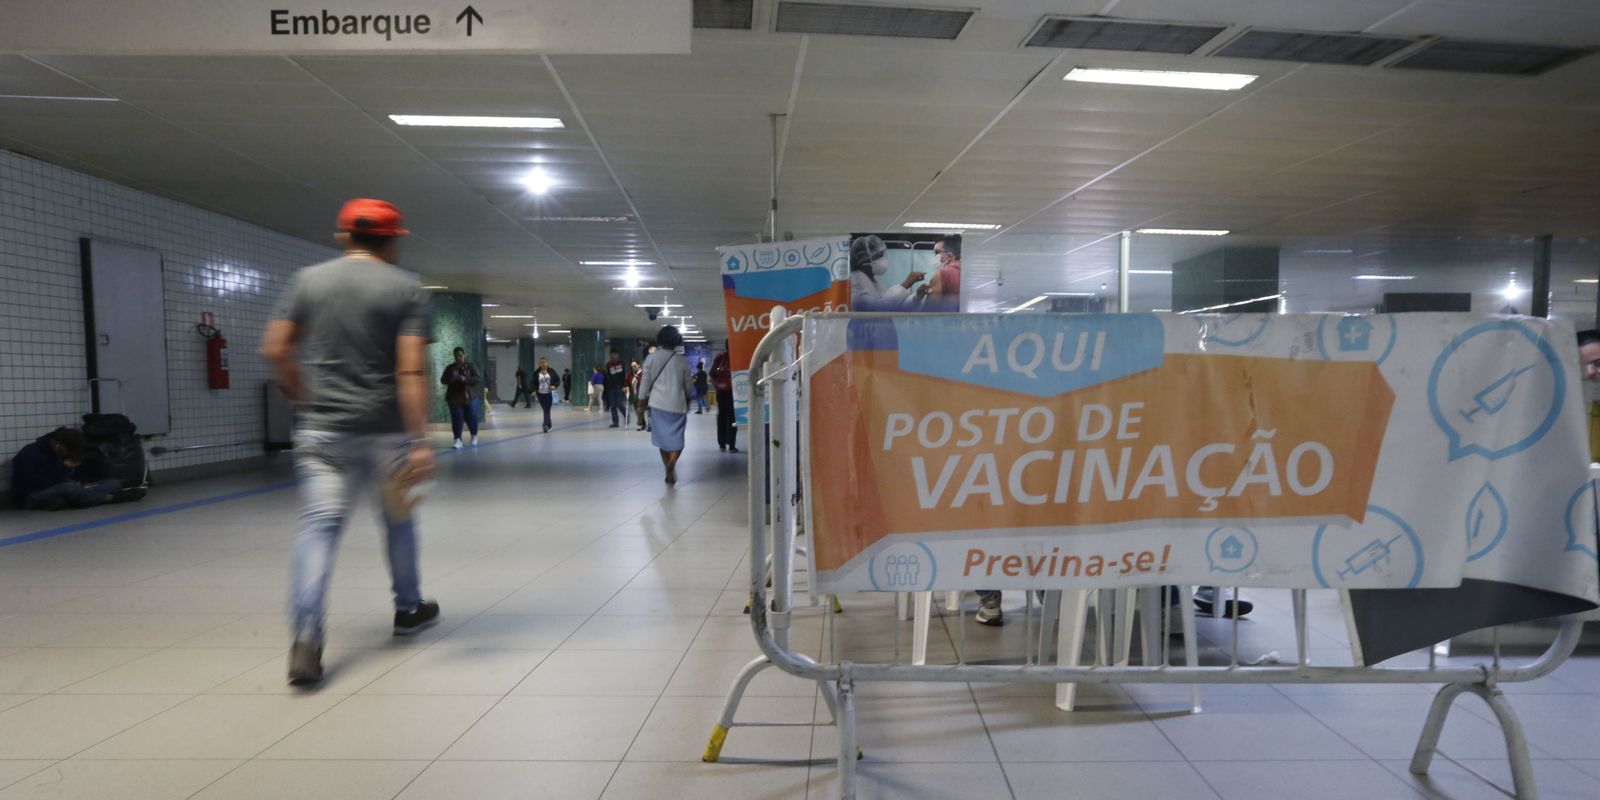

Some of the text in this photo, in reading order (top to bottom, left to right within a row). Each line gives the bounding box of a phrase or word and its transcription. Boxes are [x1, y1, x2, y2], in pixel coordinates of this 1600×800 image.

[270, 9, 431, 41] Embarque
[960, 330, 1107, 379] AQUI
[882, 402, 1144, 450] POSTO DE
[911, 428, 1335, 512] VACINAÇÃO
[963, 544, 1172, 577] Previna-se!
